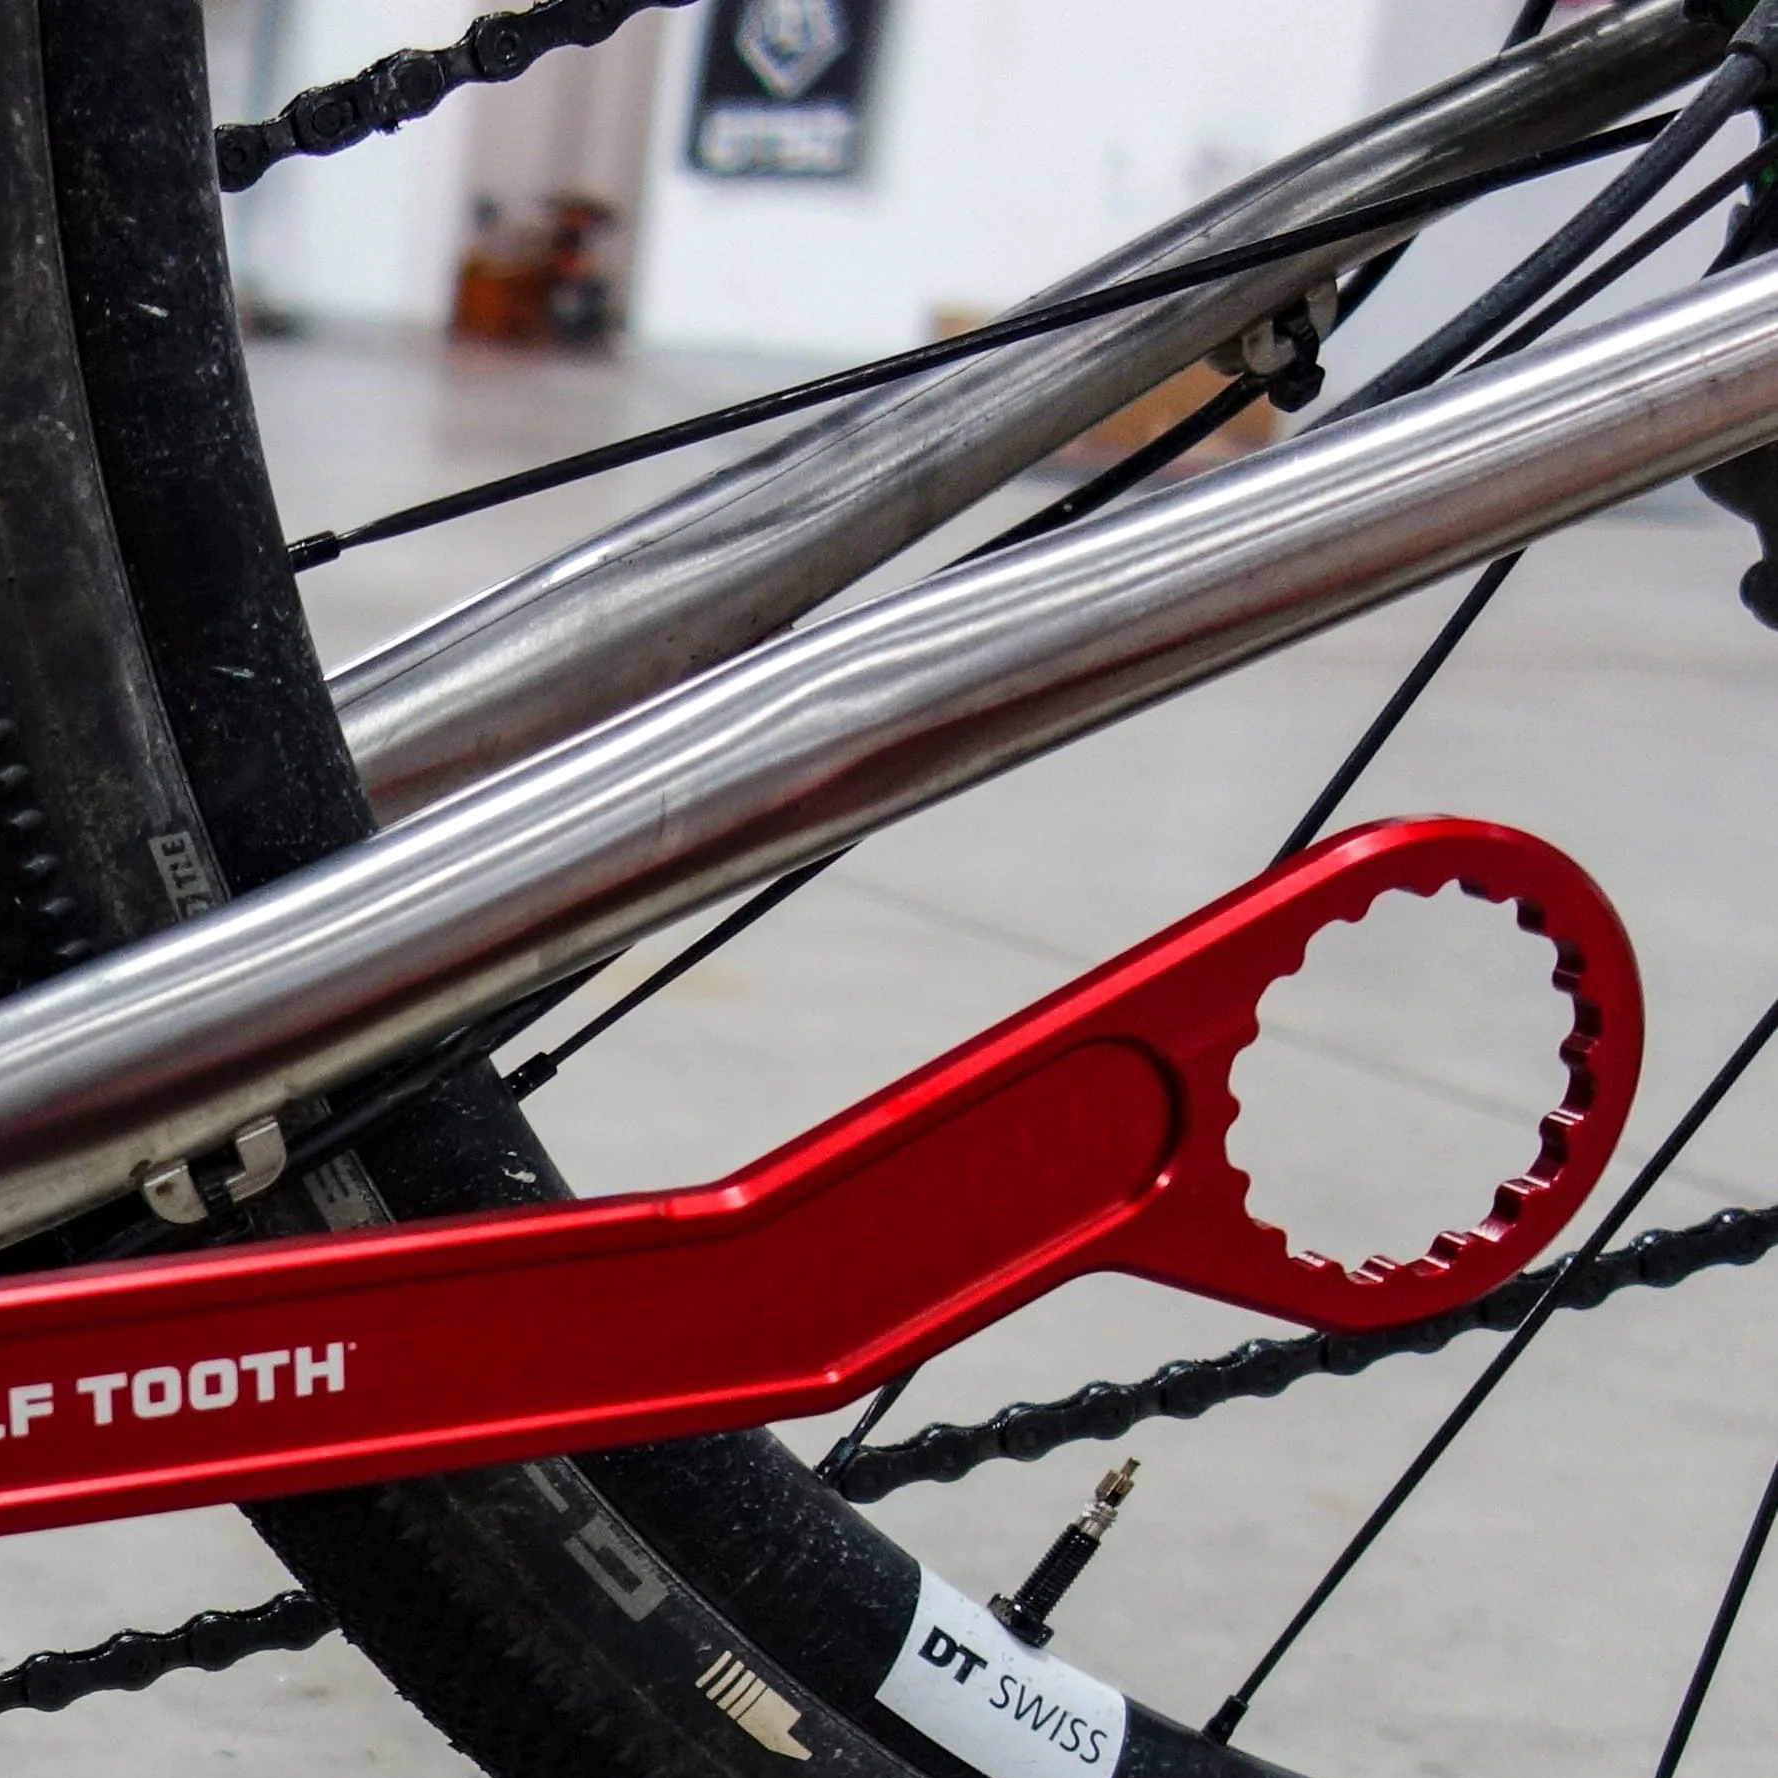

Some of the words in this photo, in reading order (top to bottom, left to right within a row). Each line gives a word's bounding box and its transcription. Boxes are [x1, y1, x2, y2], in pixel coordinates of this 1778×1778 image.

[76, 1341, 347, 1426] TOOTH
[917, 1624, 989, 1686] DT
[988, 1673, 1109, 1765] SWISS
